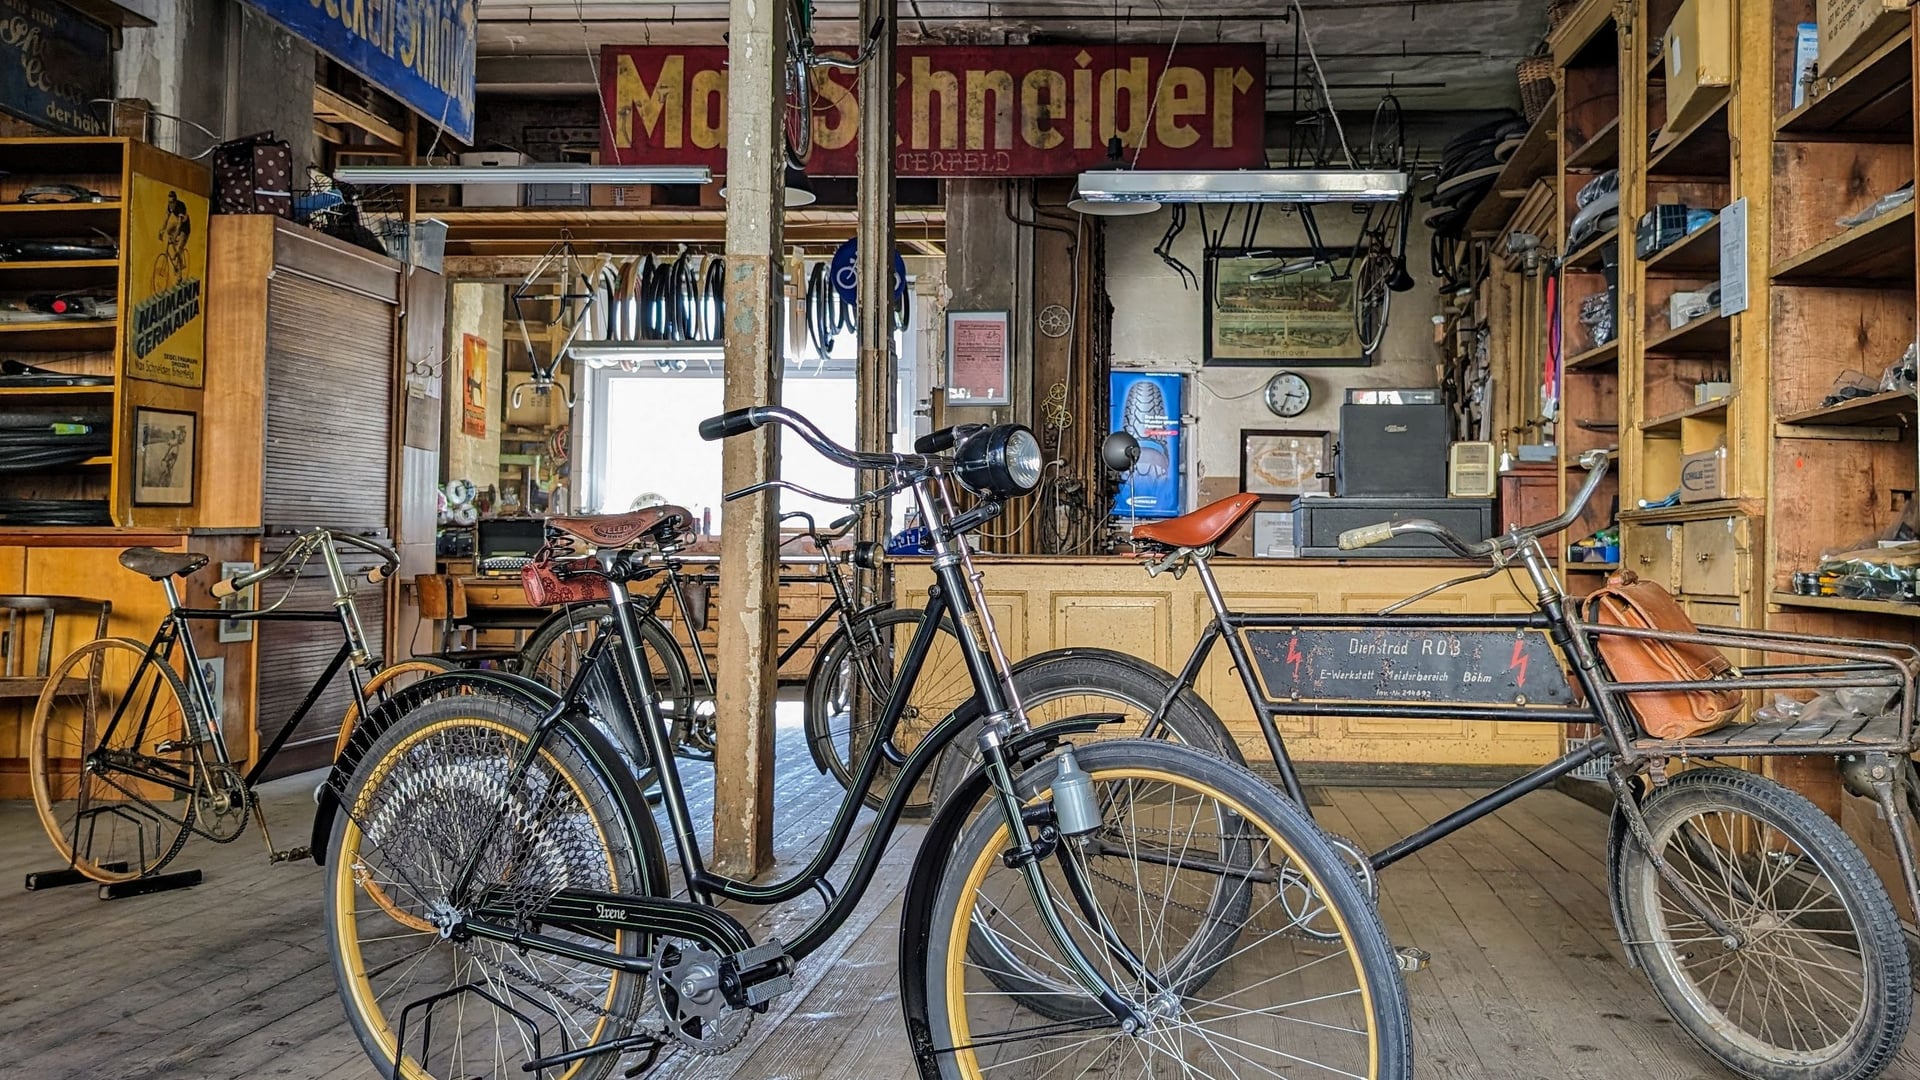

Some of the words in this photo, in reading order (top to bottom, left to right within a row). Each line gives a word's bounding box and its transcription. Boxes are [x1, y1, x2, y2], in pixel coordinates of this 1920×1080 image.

[616, 54, 729, 149] Ma
[812, 48, 1254, 150] Shneider
[897, 151, 1010, 172] TERFELD
[137, 278, 200, 335] NAUMANN
[136, 298, 200, 359] GERMANIA
[1263, 349, 1310, 357] Hannover
[1349, 638, 1409, 656] Dienstrad
[1320, 669, 1375, 681] E-Werkstatt
[1463, 671, 1493, 683] Böhm
[596, 903, 628, 920] Irene
